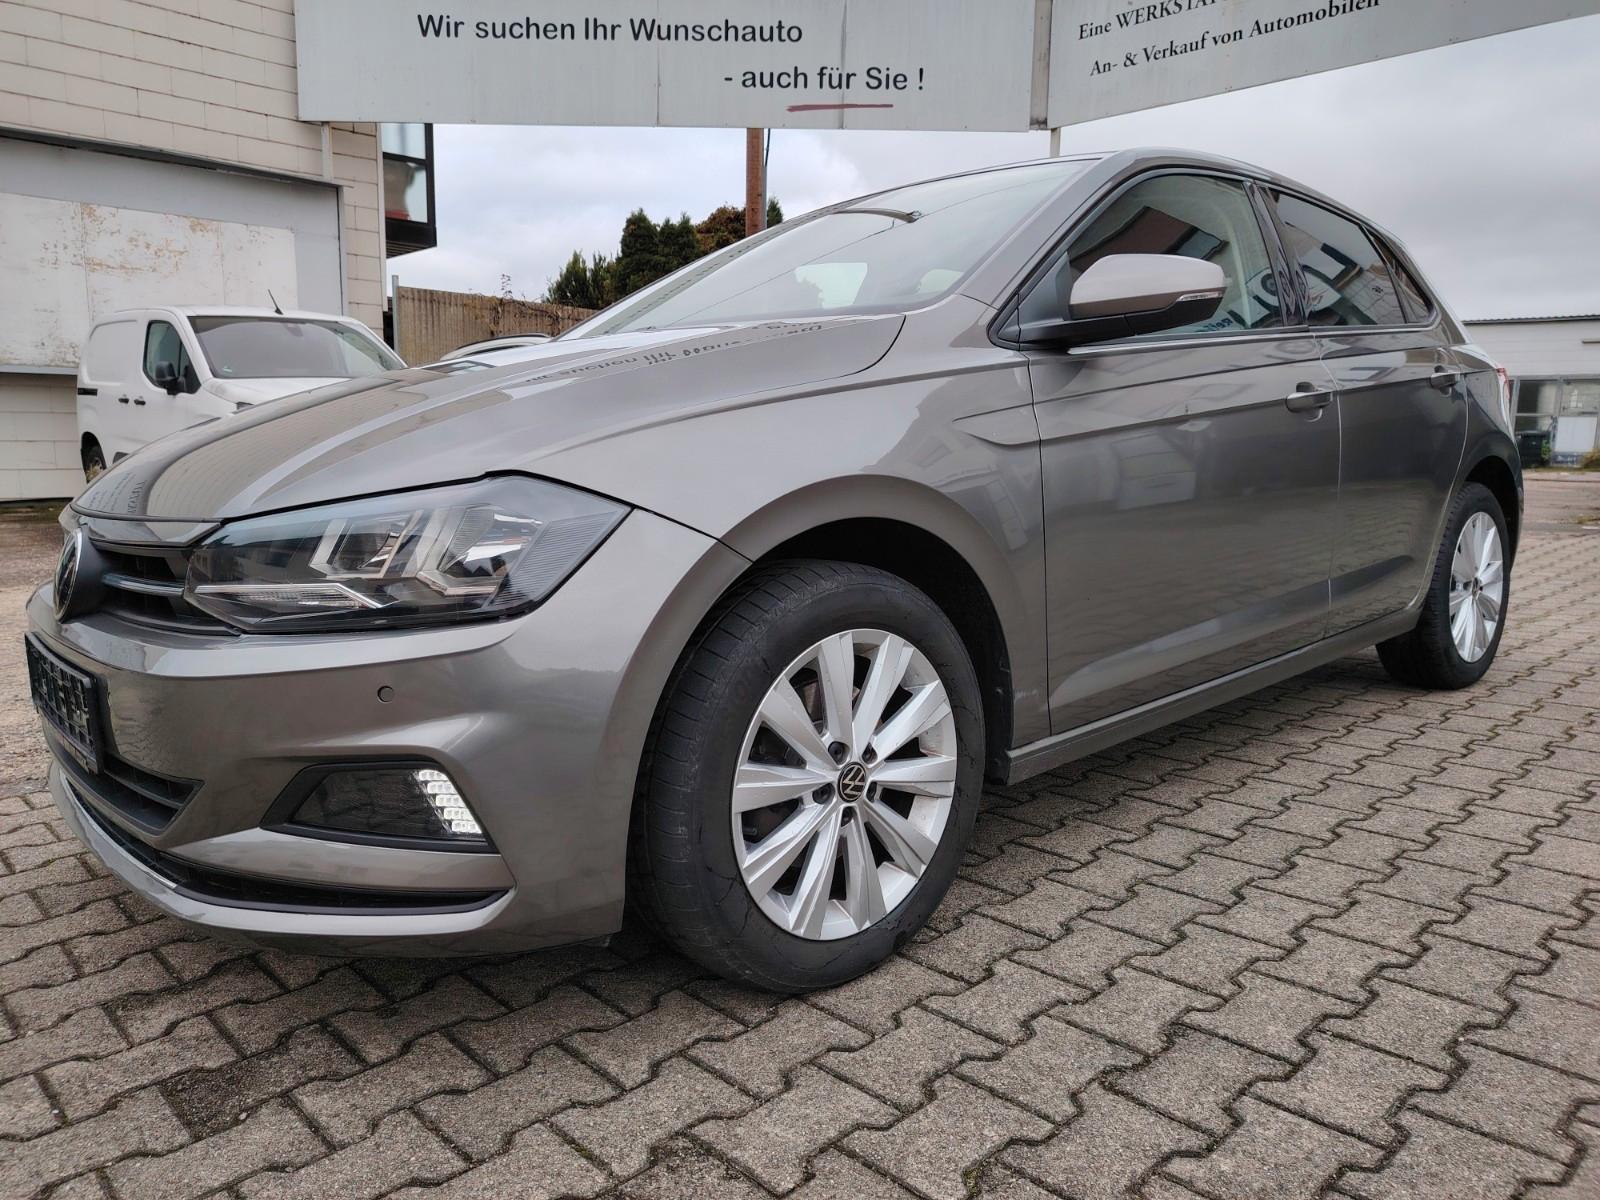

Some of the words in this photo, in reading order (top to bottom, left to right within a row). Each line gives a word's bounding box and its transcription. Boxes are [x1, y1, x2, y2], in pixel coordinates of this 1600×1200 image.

[417, 13, 465, 39] Wir
[475, 16, 576, 41] suchen
[584, 16, 622, 42] Ihr
[629, 17, 803, 43] Wunschauto
[1078, 21, 1112, 41] Eine
[1089, 60, 1118, 77] An-
[1123, 52, 1138, 68] &
[1142, 30, 1210, 63] Verkauf
[1211, 29, 1244, 47] von
[1248, 0, 1380, 38] Automobilen
[741, 65, 809, 91] auch
[816, 65, 857, 91] für
[865, 66, 908, 91] Sie
